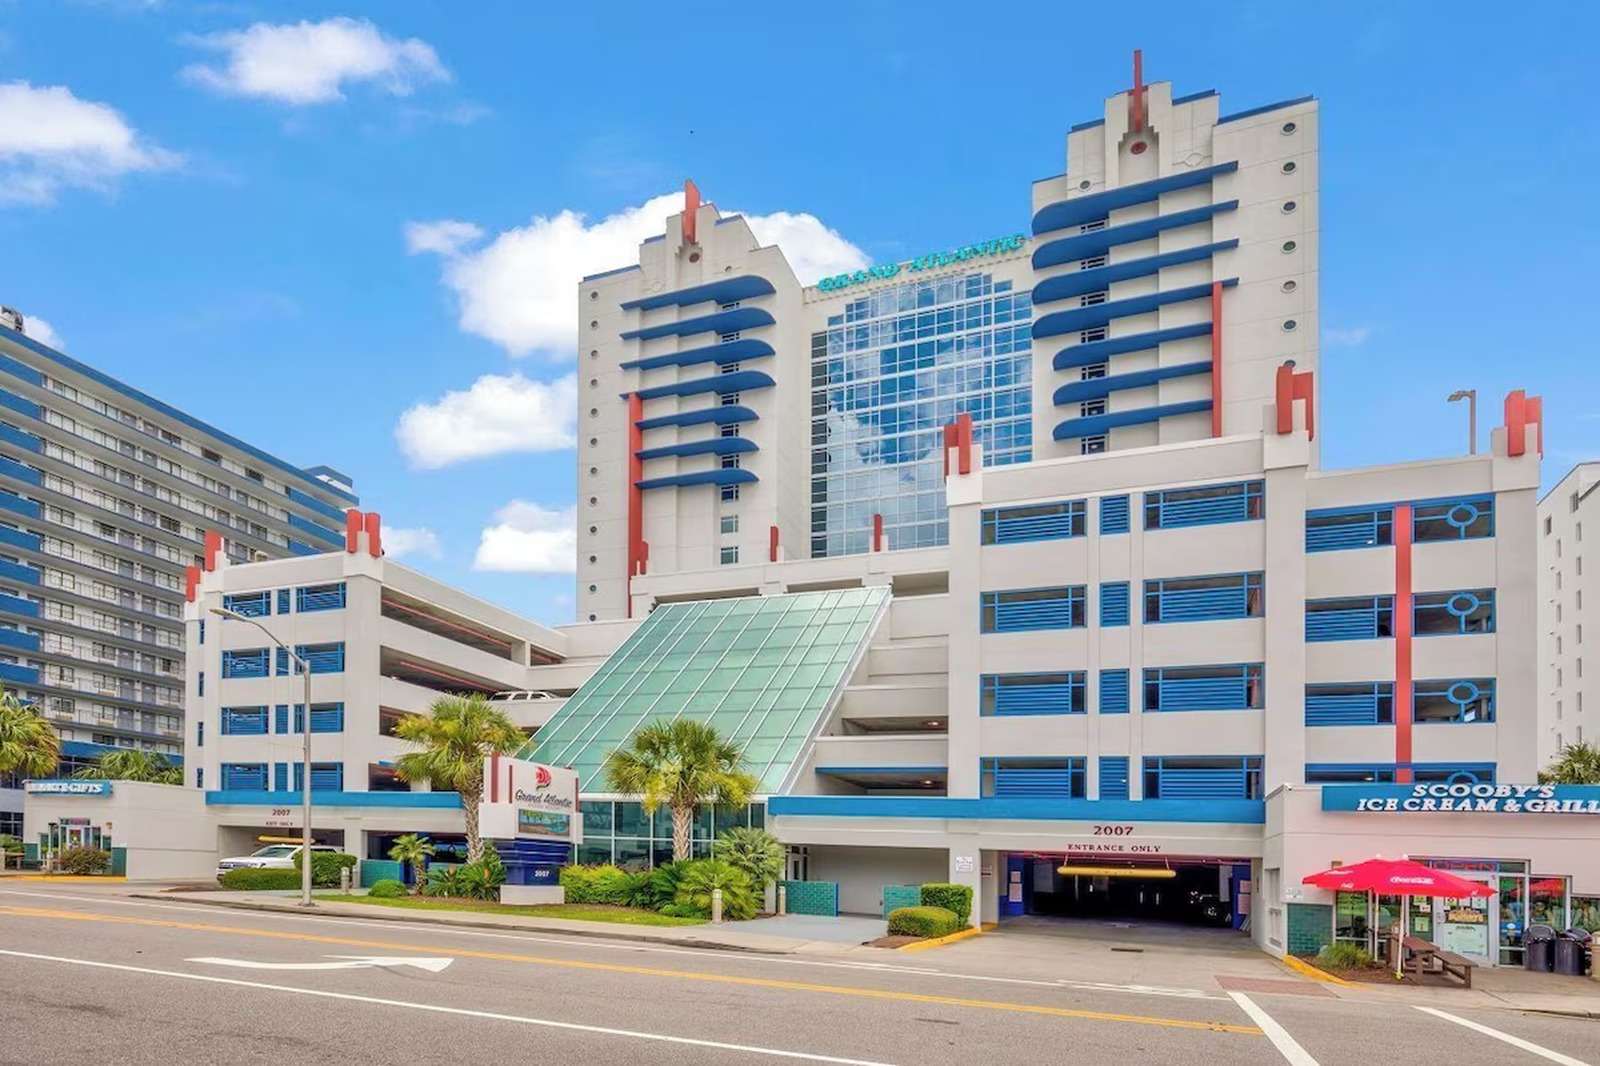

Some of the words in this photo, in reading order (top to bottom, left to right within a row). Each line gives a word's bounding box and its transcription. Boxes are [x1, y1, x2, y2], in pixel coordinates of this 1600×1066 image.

[818, 263, 900, 291] GRAND
[909, 233, 1025, 271] ATLANTIC
[1412, 784, 1556, 798] SCOOBY'S
[515, 789, 543, 803] Grand
[544, 793, 572, 808] Atlantic
[1357, 798, 1399, 811] ICE
[1403, 798, 1497, 811] CREAM
[1503, 798, 1521, 812] &
[1524, 799, 1600, 814] GRILL
[1093, 825, 1134, 836] 2007
[1067, 843, 1125, 852] ENTRANCE
[1434, 860, 1496, 872] OPEN
